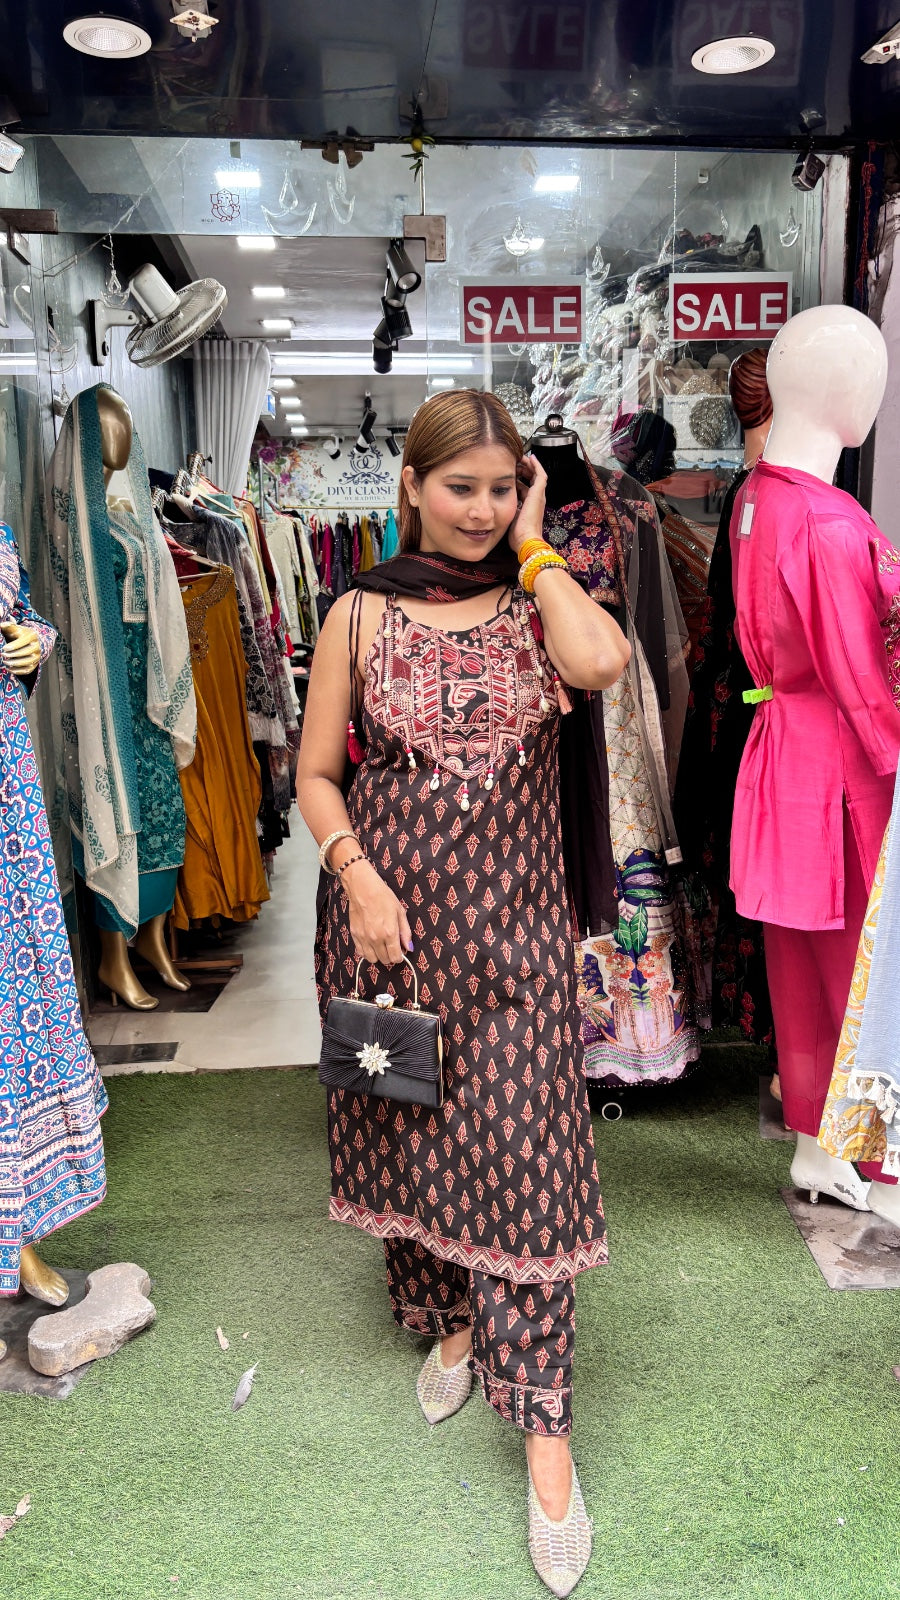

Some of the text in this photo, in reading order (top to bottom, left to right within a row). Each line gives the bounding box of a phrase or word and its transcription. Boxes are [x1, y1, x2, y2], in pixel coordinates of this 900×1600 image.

[466, 296, 578, 335] SALE
[675, 293, 785, 331] SALE
[327, 486, 352, 495] DIVI
